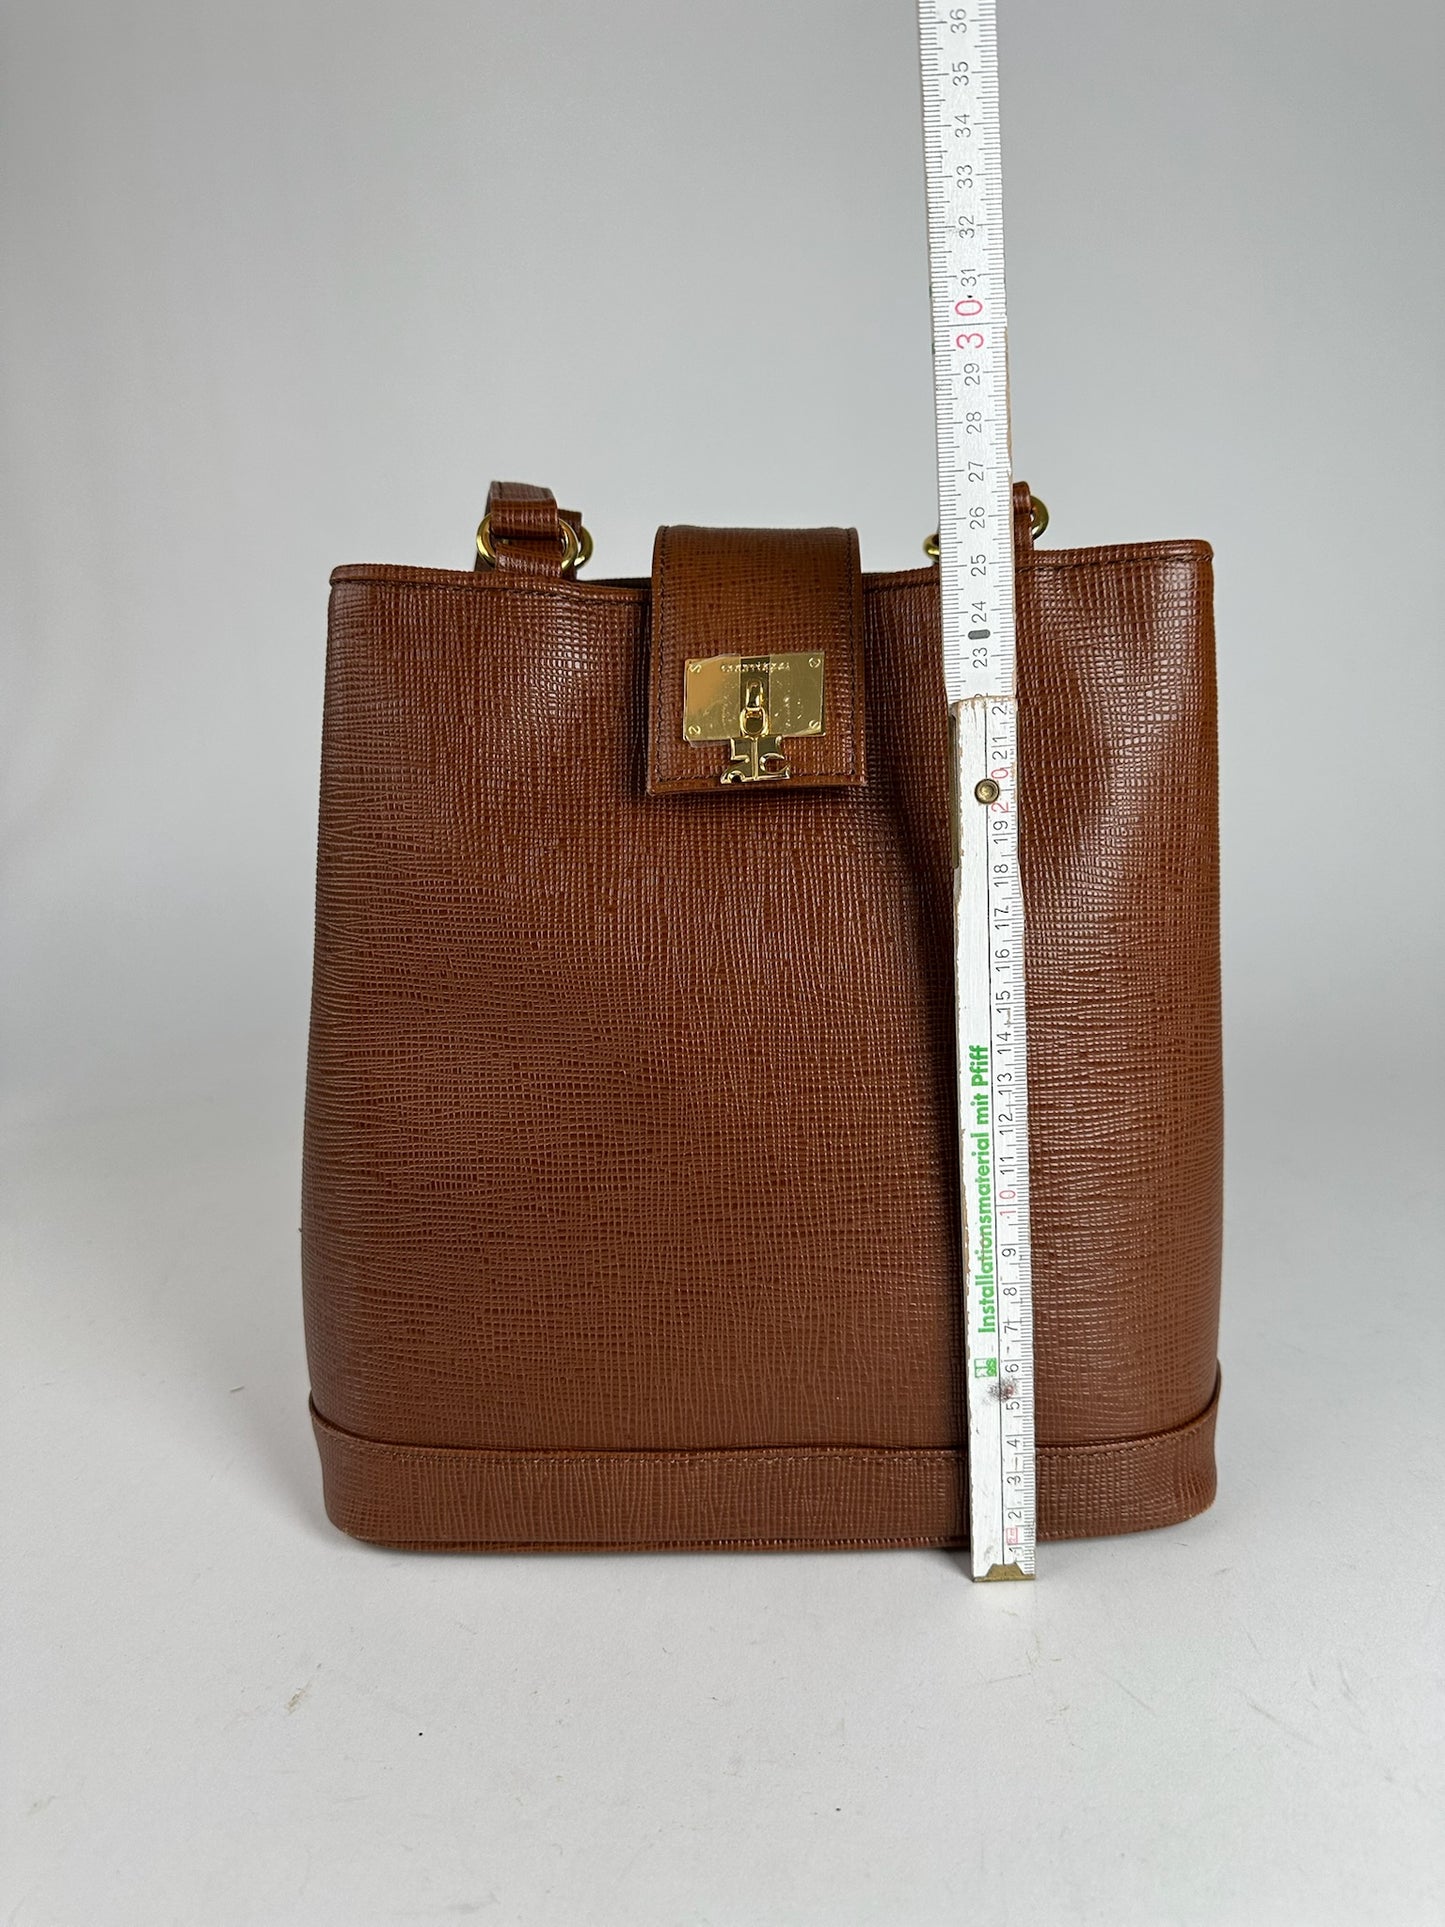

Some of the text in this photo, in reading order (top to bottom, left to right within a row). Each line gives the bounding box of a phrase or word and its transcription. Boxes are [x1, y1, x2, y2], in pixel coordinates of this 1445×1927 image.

[950, 8, 967, 33] 36
[952, 61, 969, 86] 35
[954, 114, 971, 138] 34
[956, 164, 973, 189] 33
[958, 215, 975, 239] 32
[960, 268, 977, 287] 31
[955, 299, 984, 349] 30
[963, 363, 980, 386] 29
[966, 411, 982, 435] 28
[968, 461, 984, 482] 27
[969, 506, 985, 530] 26
[970, 554, 986, 577] 25
[971, 600, 987, 623] 24
[972, 647, 988, 668] 23
[992, 736, 1008, 760] 21
[991, 767, 1009, 812] 20
[993, 820, 1009, 844] 19
[993, 863, 1009, 887] 18
[994, 905, 1009, 930] 17
[995, 948, 1010, 972] 16
[996, 990, 1011, 1014] 15
[996, 1032, 1012, 1055] 14
[968, 1045, 989, 1086] Pfiff
[997, 1072, 1013, 1096] 13
[970, 1093, 989, 1125] mit
[998, 1113, 1014, 1135] 12
[999, 1156, 1014, 1175] 11
[999, 1190, 1016, 1216] 10
[970, 1132, 996, 1333] Installationsmaterial
[1001, 1248, 1016, 1258] 9
[1003, 1287, 1017, 1296] 8
[1004, 1325, 1018, 1334] 7
[1005, 1363, 1019, 1373] 6
[1006, 1401, 1020, 1411] 5
[1007, 1438, 1021, 1448] 4
[1007, 1475, 1021, 1485] 3
[1008, 1510, 1022, 1519] 2
